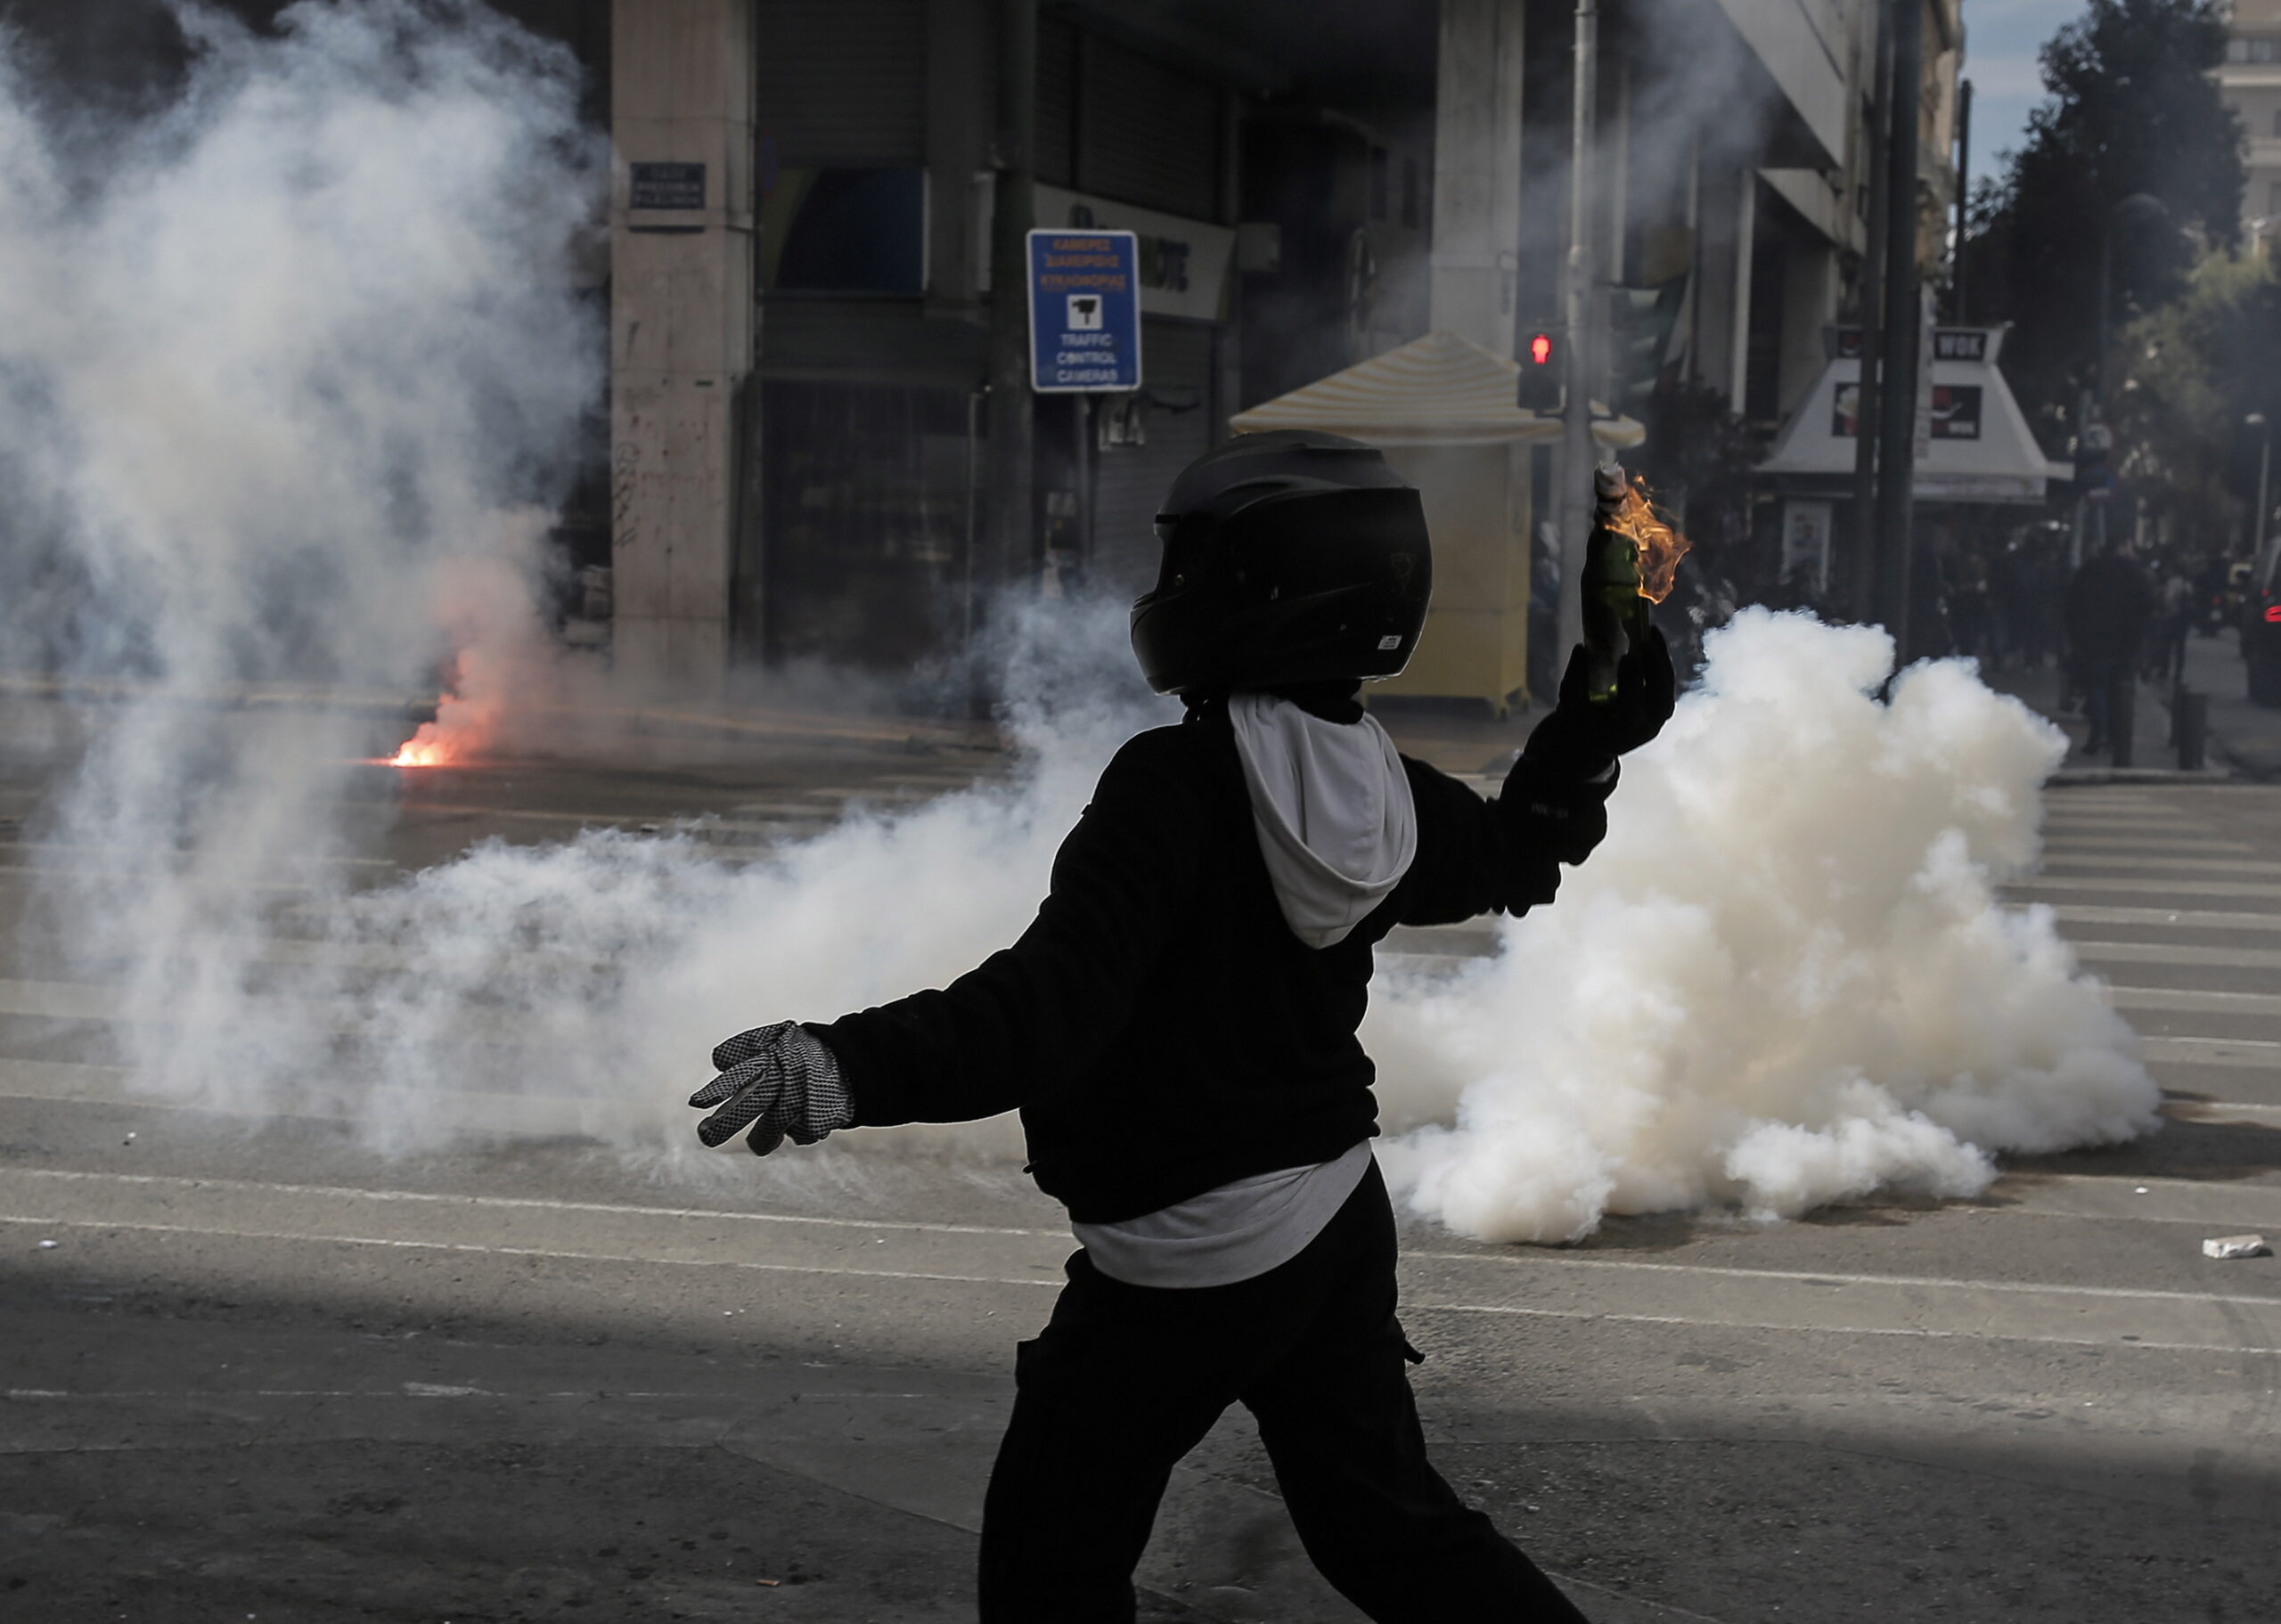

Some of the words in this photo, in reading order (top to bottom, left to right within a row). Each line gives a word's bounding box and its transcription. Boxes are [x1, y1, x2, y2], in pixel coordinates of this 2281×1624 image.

[1060, 333, 1112, 347] TRAFFIC
[1939, 336, 1981, 356] WOK
[1057, 351, 1118, 366] CONTROL
[1057, 369, 1119, 383] CAMERAS
